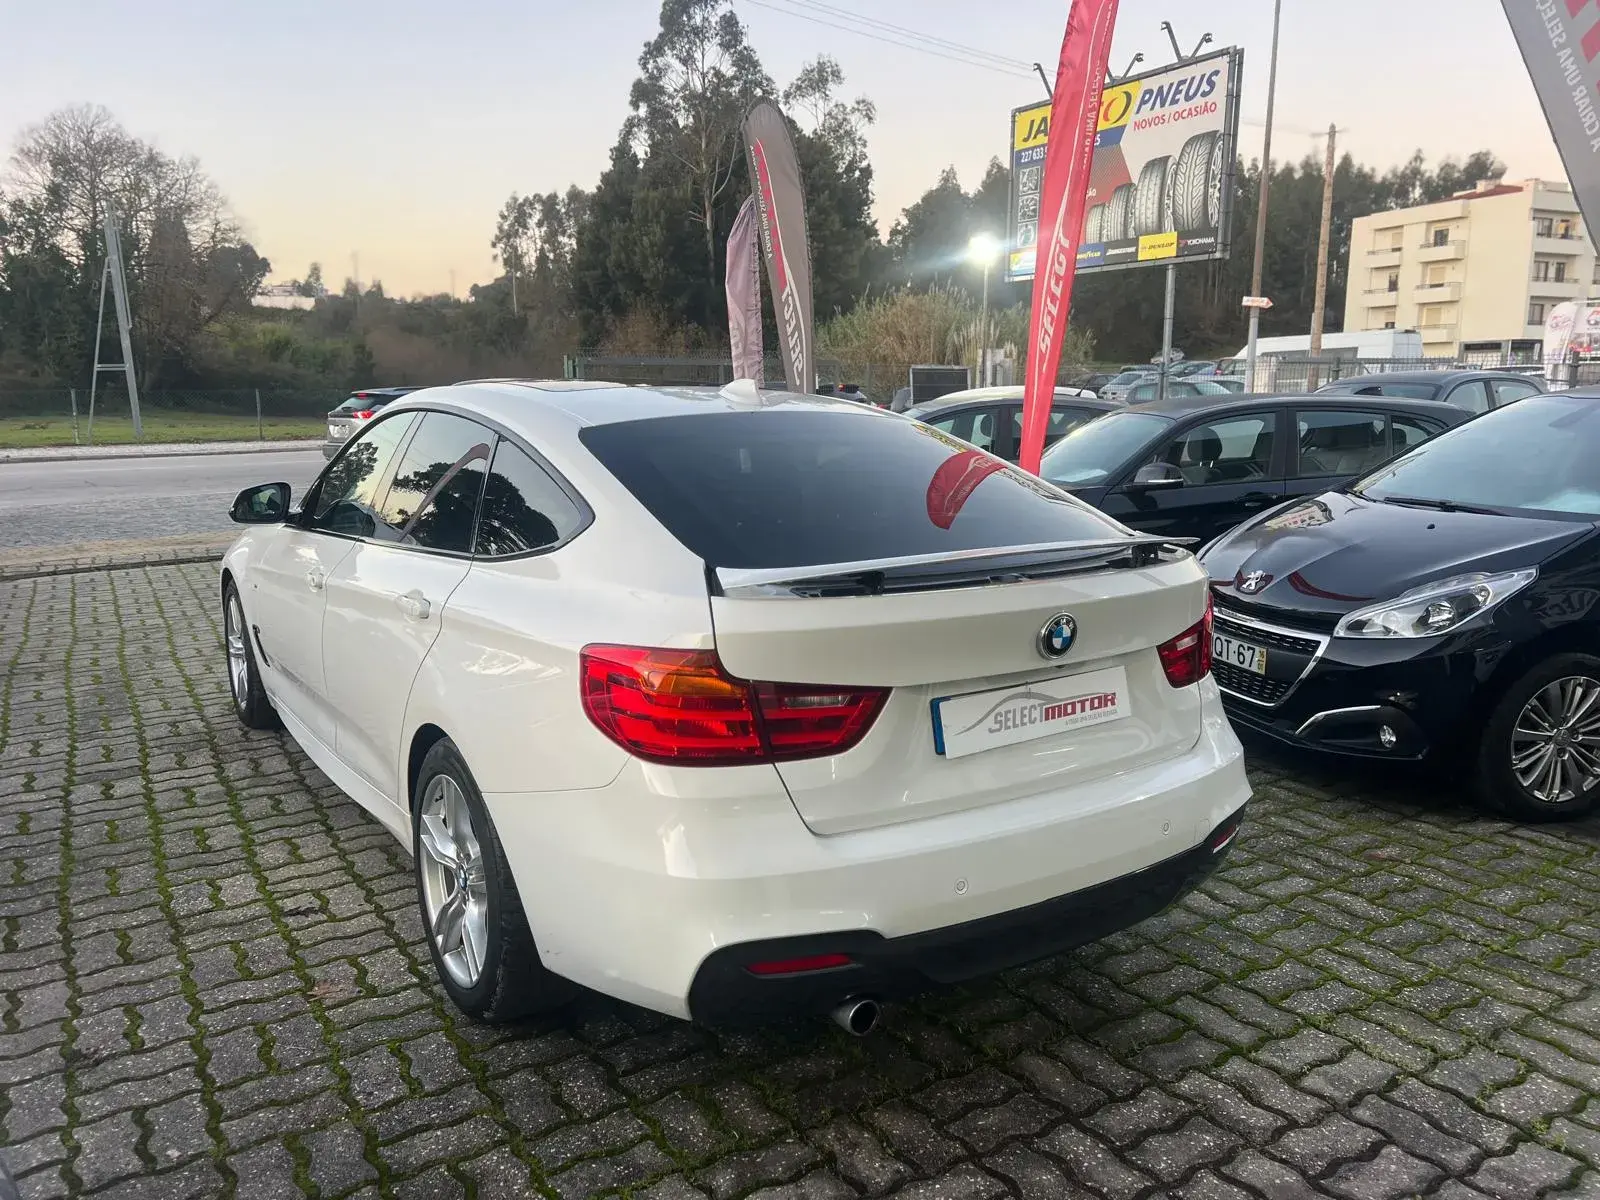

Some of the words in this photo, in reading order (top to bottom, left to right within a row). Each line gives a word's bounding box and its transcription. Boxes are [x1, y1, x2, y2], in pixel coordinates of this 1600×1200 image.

[1135, 69, 1221, 115] PNEUS
[1133, 114, 1166, 131] NOVOS
[1173, 101, 1217, 121] OCASIÃO
